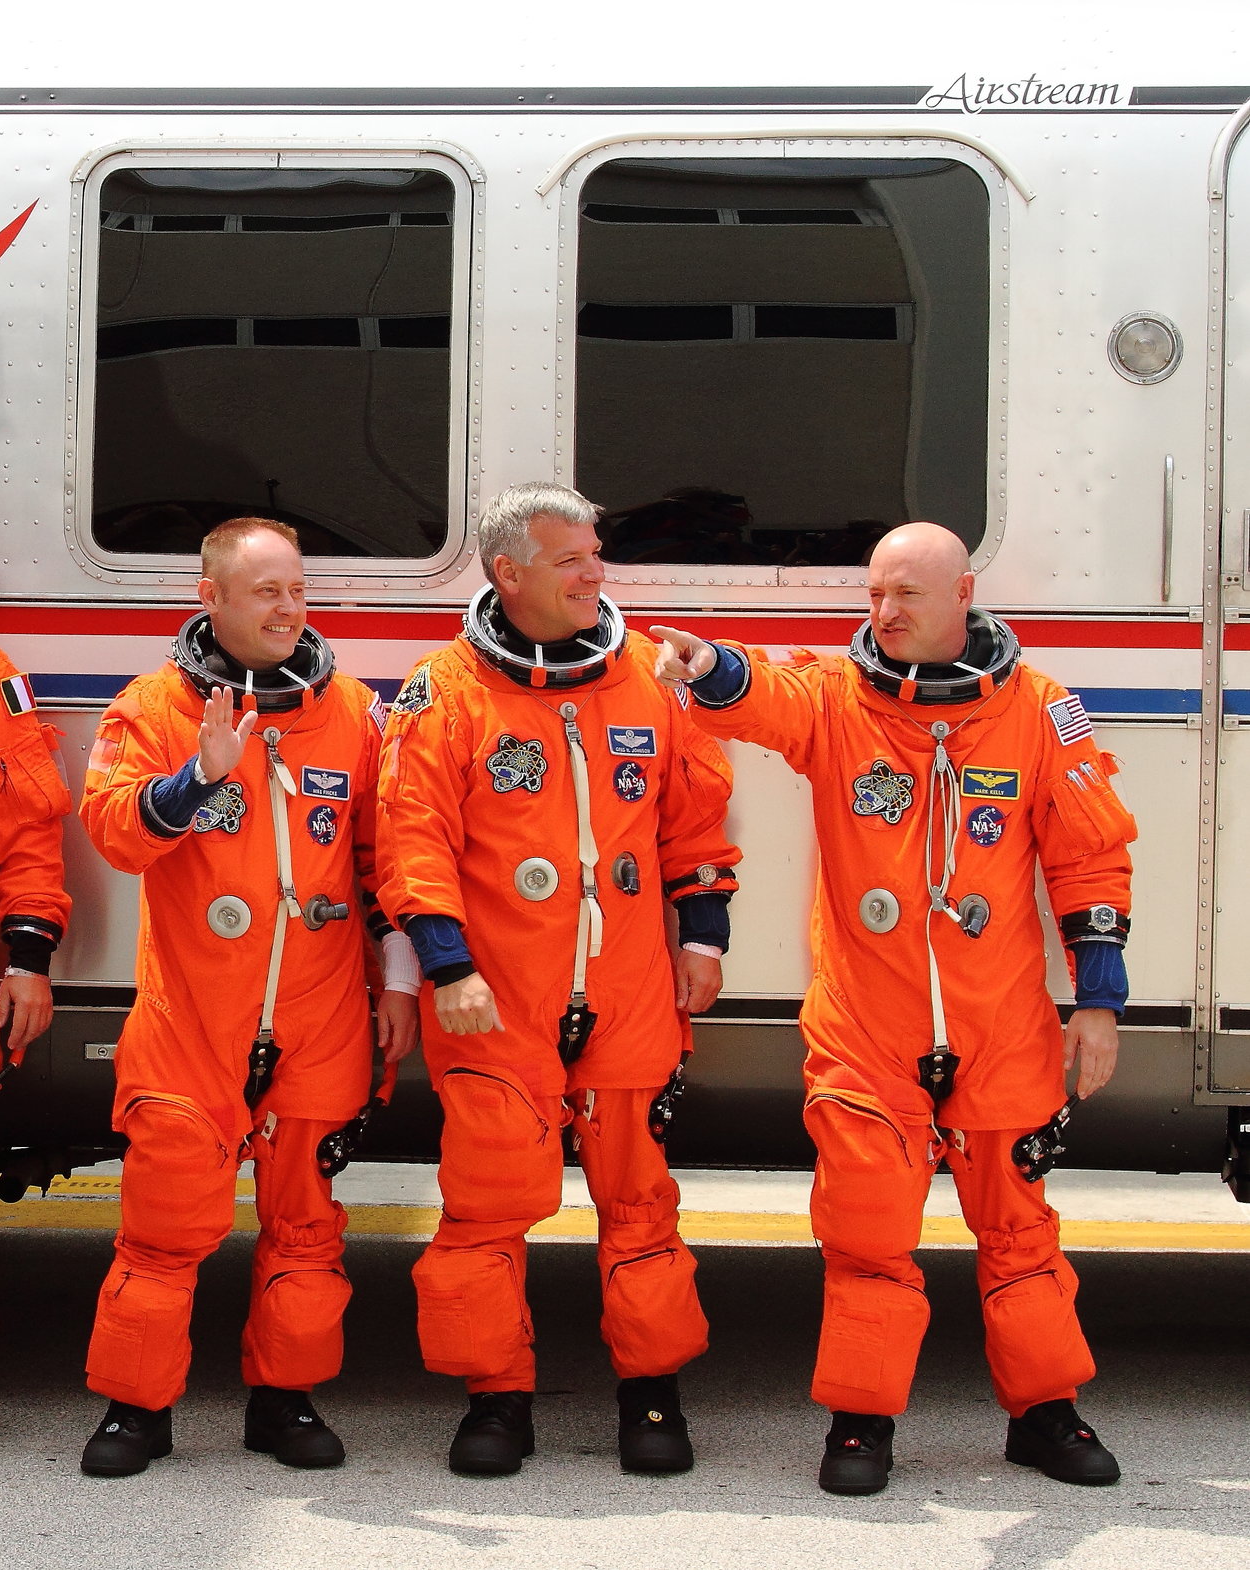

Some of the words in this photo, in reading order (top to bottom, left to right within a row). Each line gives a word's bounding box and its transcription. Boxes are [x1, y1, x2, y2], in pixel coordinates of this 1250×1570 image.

[925, 72, 1124, 114] Airstream
[617, 778, 645, 789] NASA
[312, 820, 336, 833] NASA
[971, 820, 1002, 834] NASA
